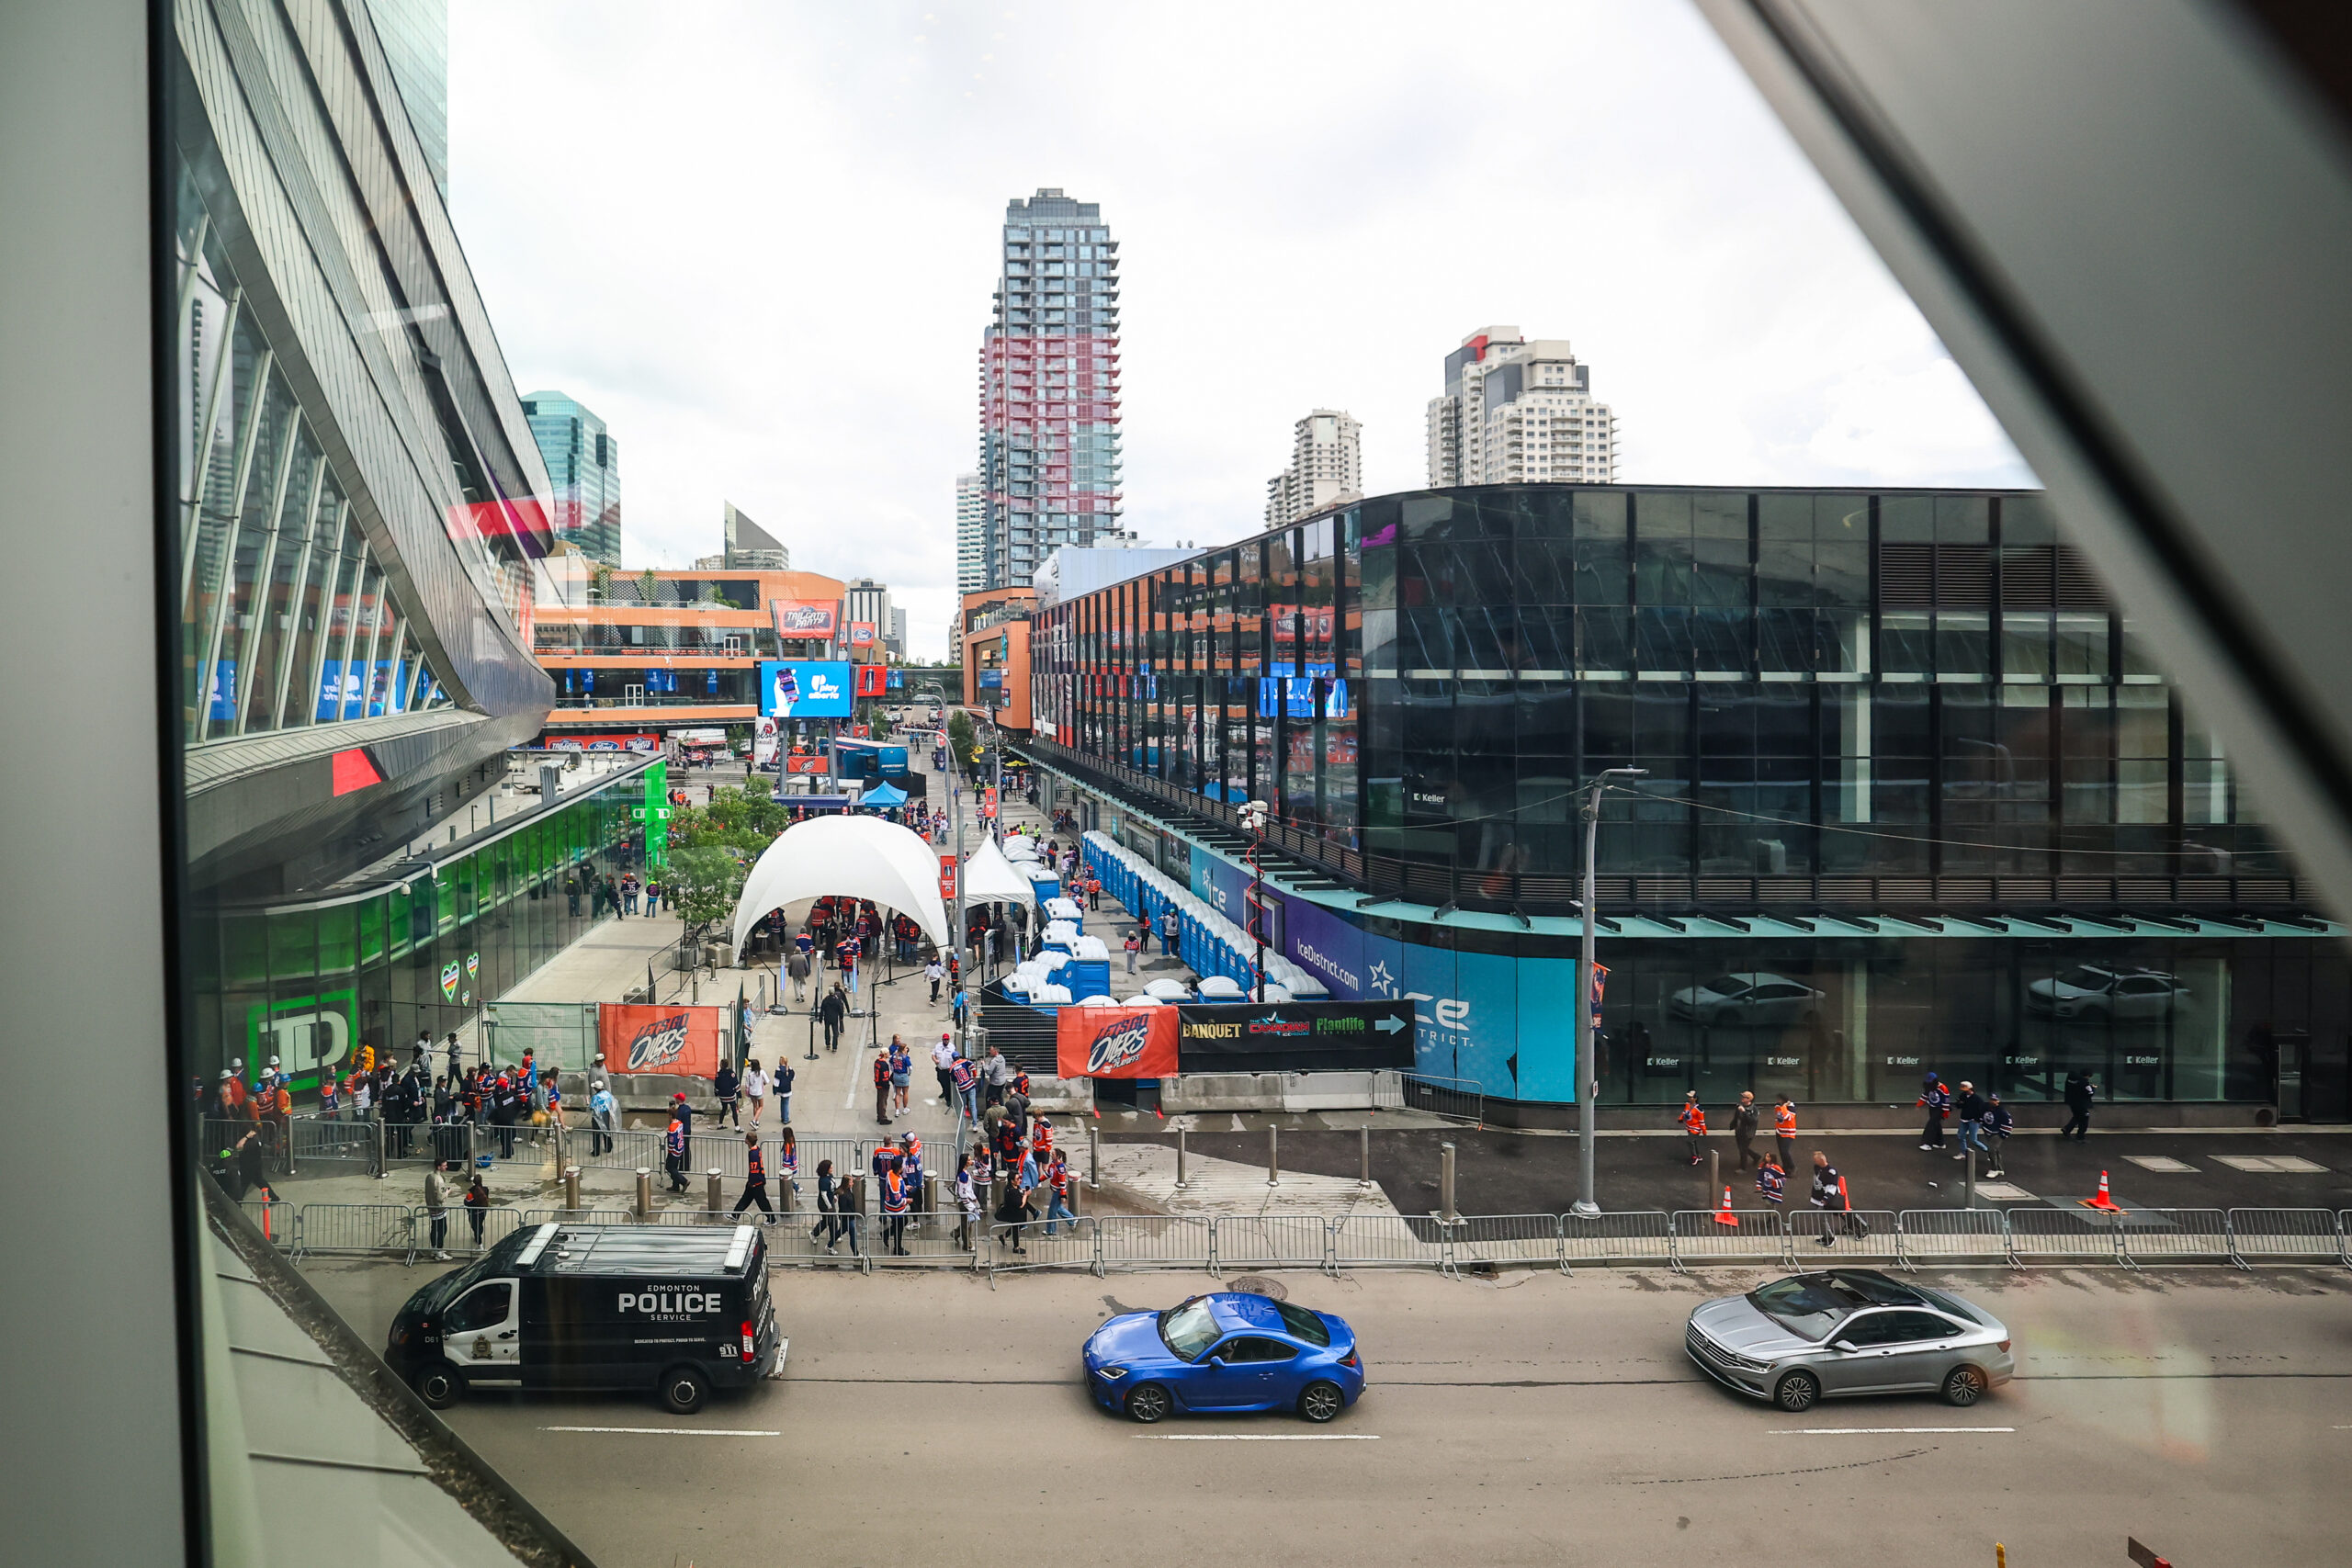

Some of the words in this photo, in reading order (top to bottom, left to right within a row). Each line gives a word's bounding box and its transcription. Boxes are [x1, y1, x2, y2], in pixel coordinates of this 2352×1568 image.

[787, 611, 827, 620] TAILGATE
[795, 618, 825, 630] PARTY
[819, 684, 840, 693] play
[808, 692, 840, 700] alberta
[1422, 794, 1445, 803] Keller
[655, 808, 671, 819] TD
[1297, 938, 1359, 991] IceDistrict.com
[1249, 1021, 1310, 1033] CANADIAN
[1317, 1017, 1365, 1031] Plantlife
[1182, 1023, 1242, 1039] BANQUET
[258, 1010, 349, 1075] TD
[628, 1027, 688, 1070] OILERS
[1087, 1027, 1148, 1073] OILERS
[1656, 1057, 1679, 1066] Keller
[1777, 1056, 1800, 1066] Keller
[1896, 1056, 1919, 1065] Keller
[2014, 1055, 2038, 1065] Keller
[2135, 1055, 2159, 1064] Keller
[955, 1068, 969, 1084] 18
[618, 1293, 721, 1313] POLICE
[719, 1346, 738, 1355] 911
